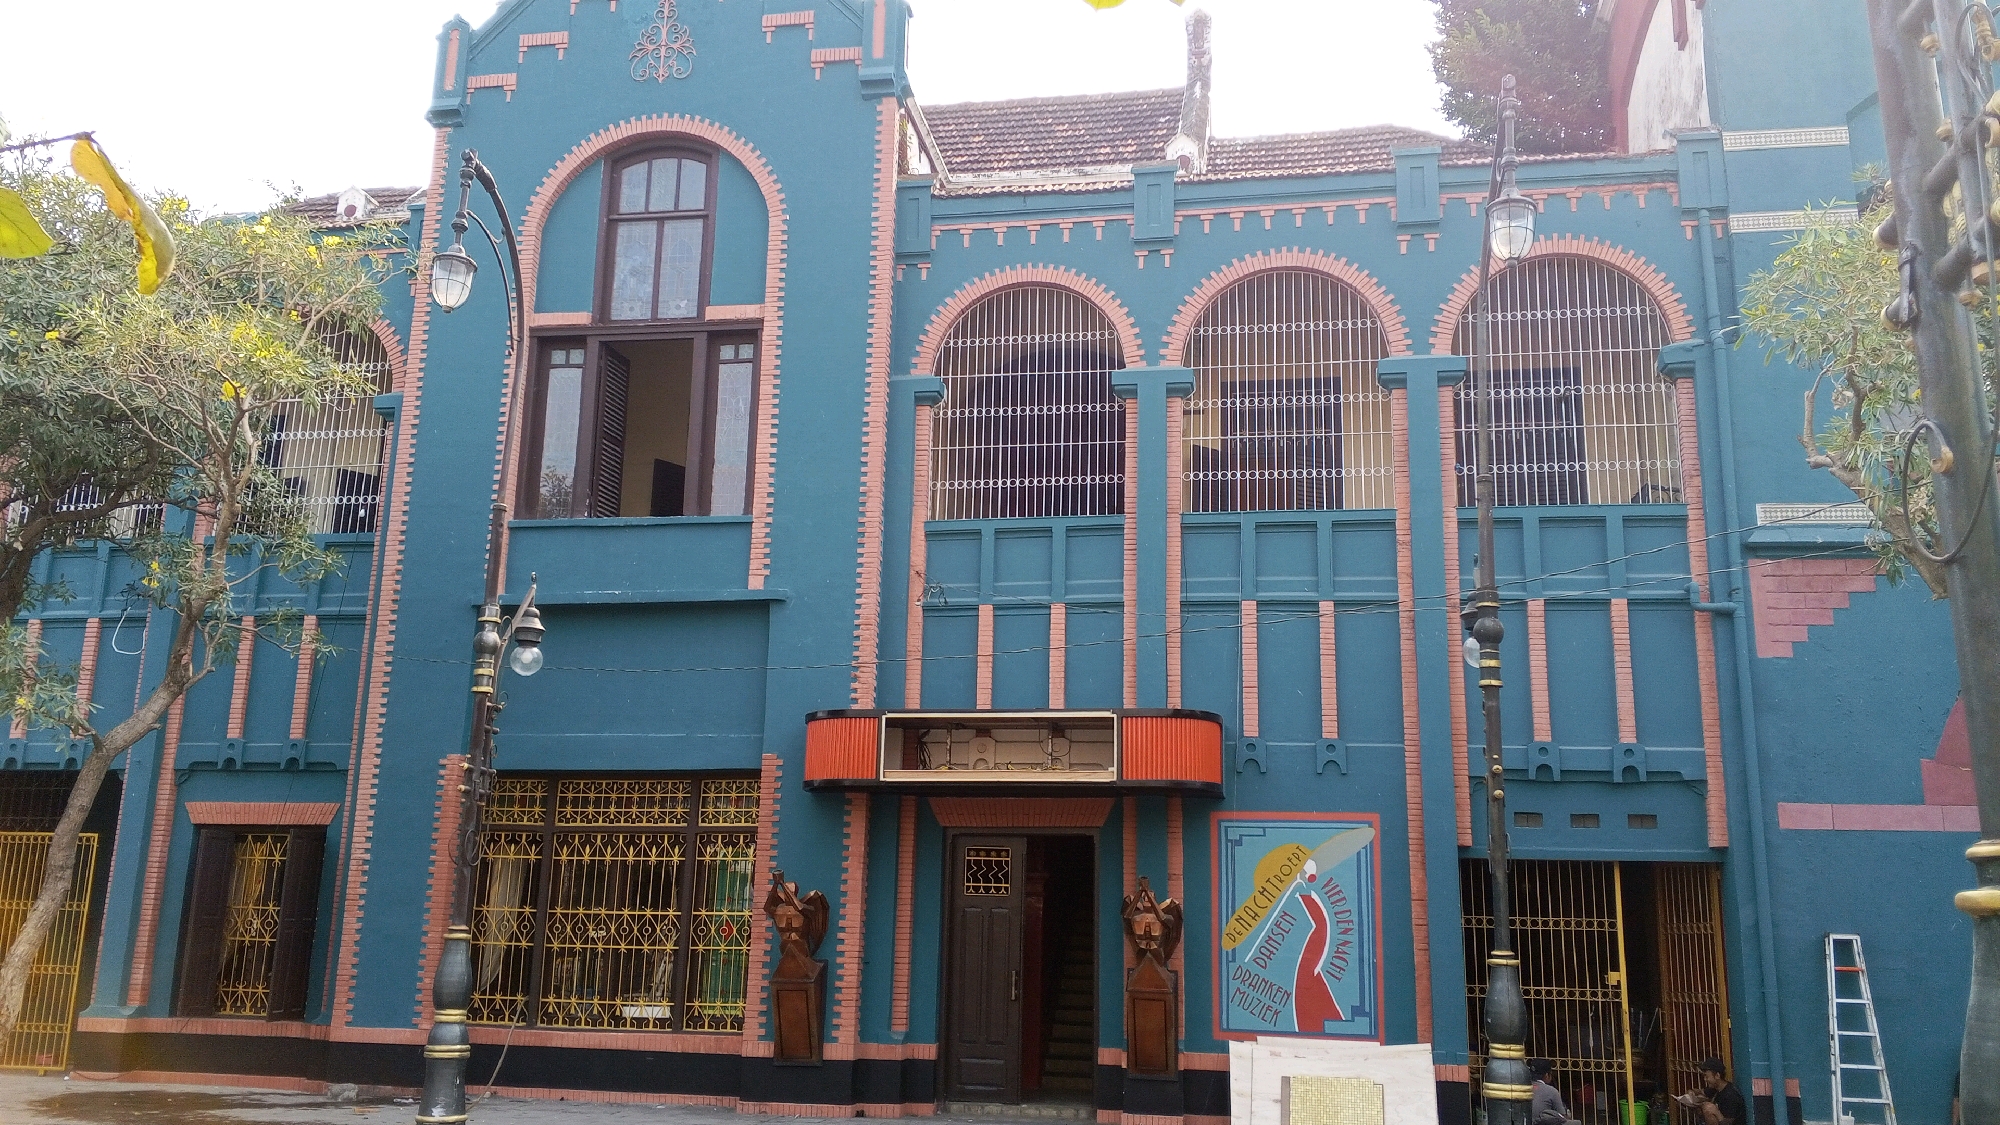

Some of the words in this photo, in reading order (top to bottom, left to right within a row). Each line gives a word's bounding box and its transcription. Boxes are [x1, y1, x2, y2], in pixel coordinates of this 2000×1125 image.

[1226, 927, 1243, 943] DE
[1235, 877, 1282, 932] NACHT
[1273, 845, 1307, 884] ROEPT
[1321, 876, 1347, 909] VIER
[1253, 910, 1297, 970] DANSEN
[1334, 909, 1354, 935] DEN
[1325, 939, 1354, 982] NACHT
[1230, 987, 1282, 1027] MUZIEK
[1232, 965, 1291, 1013] DRANKEN
